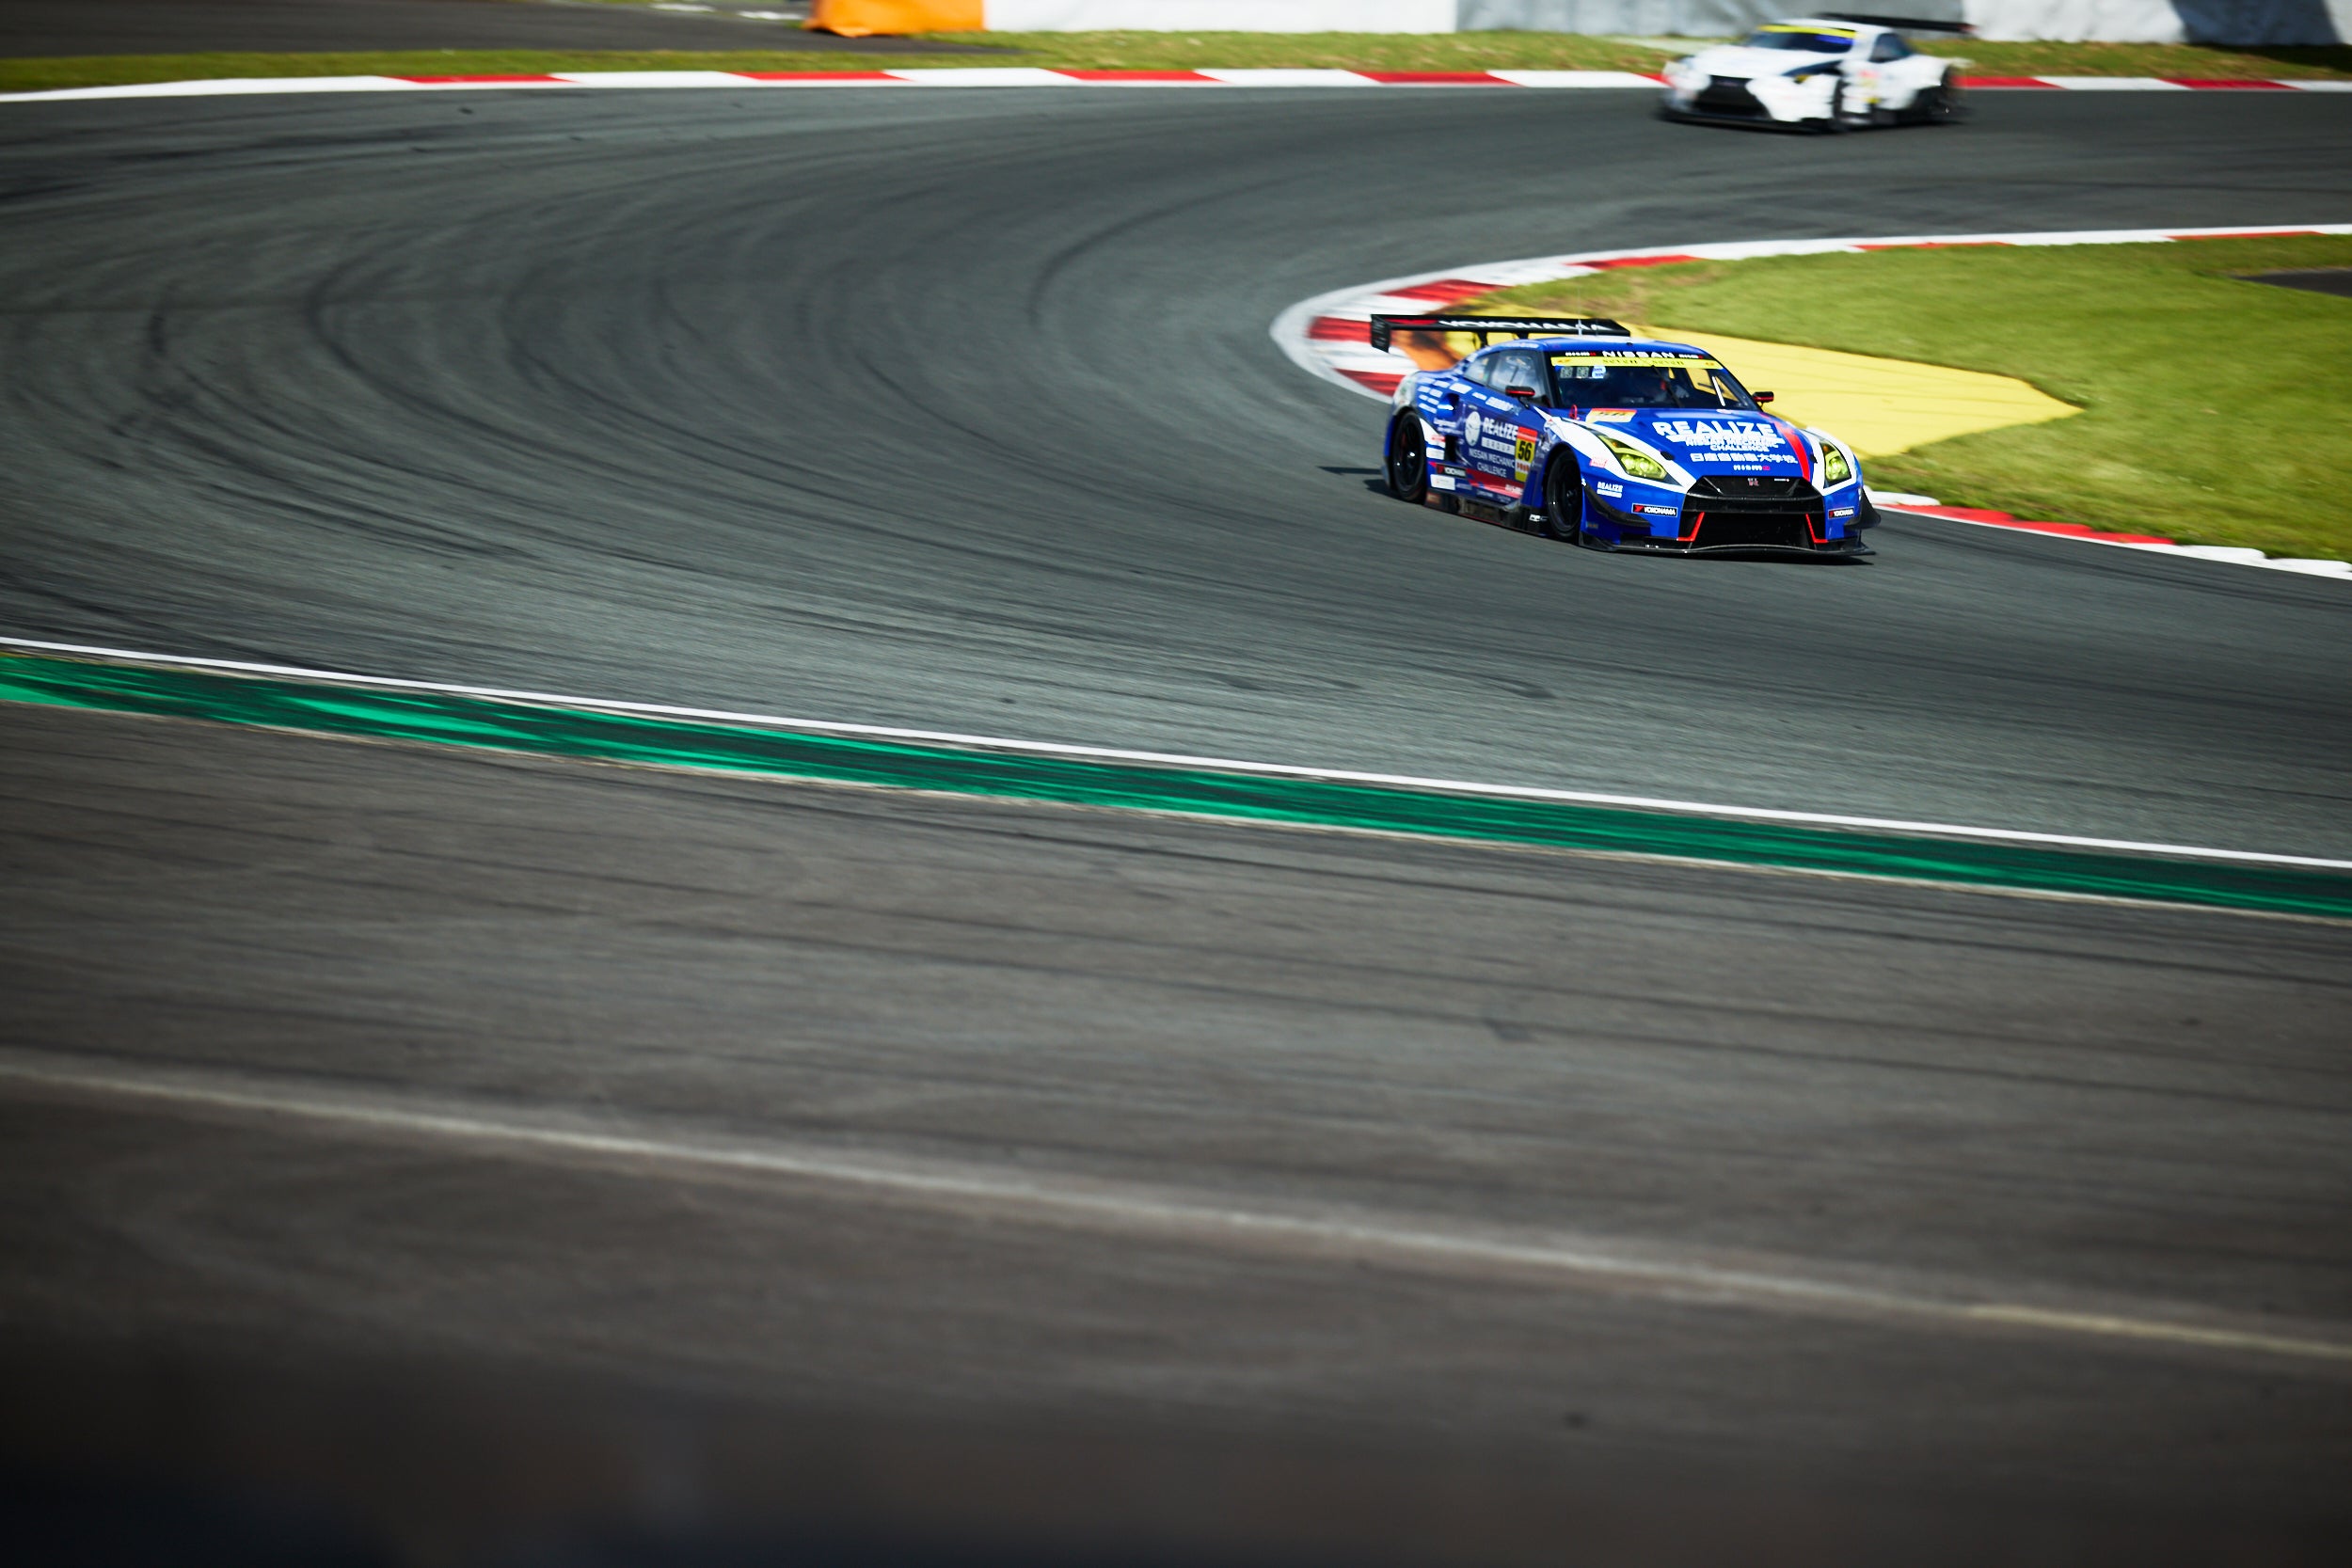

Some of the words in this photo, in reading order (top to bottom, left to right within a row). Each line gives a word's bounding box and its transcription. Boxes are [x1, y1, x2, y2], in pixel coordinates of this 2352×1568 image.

[1601, 350, 1676, 359] NISSAN
[1482, 417, 1518, 442] REALIZE
[1652, 420, 1777, 437] REALIZE
[1518, 440, 1532, 462] 56
[1645, 507, 1677, 516] YOKOHAMA
